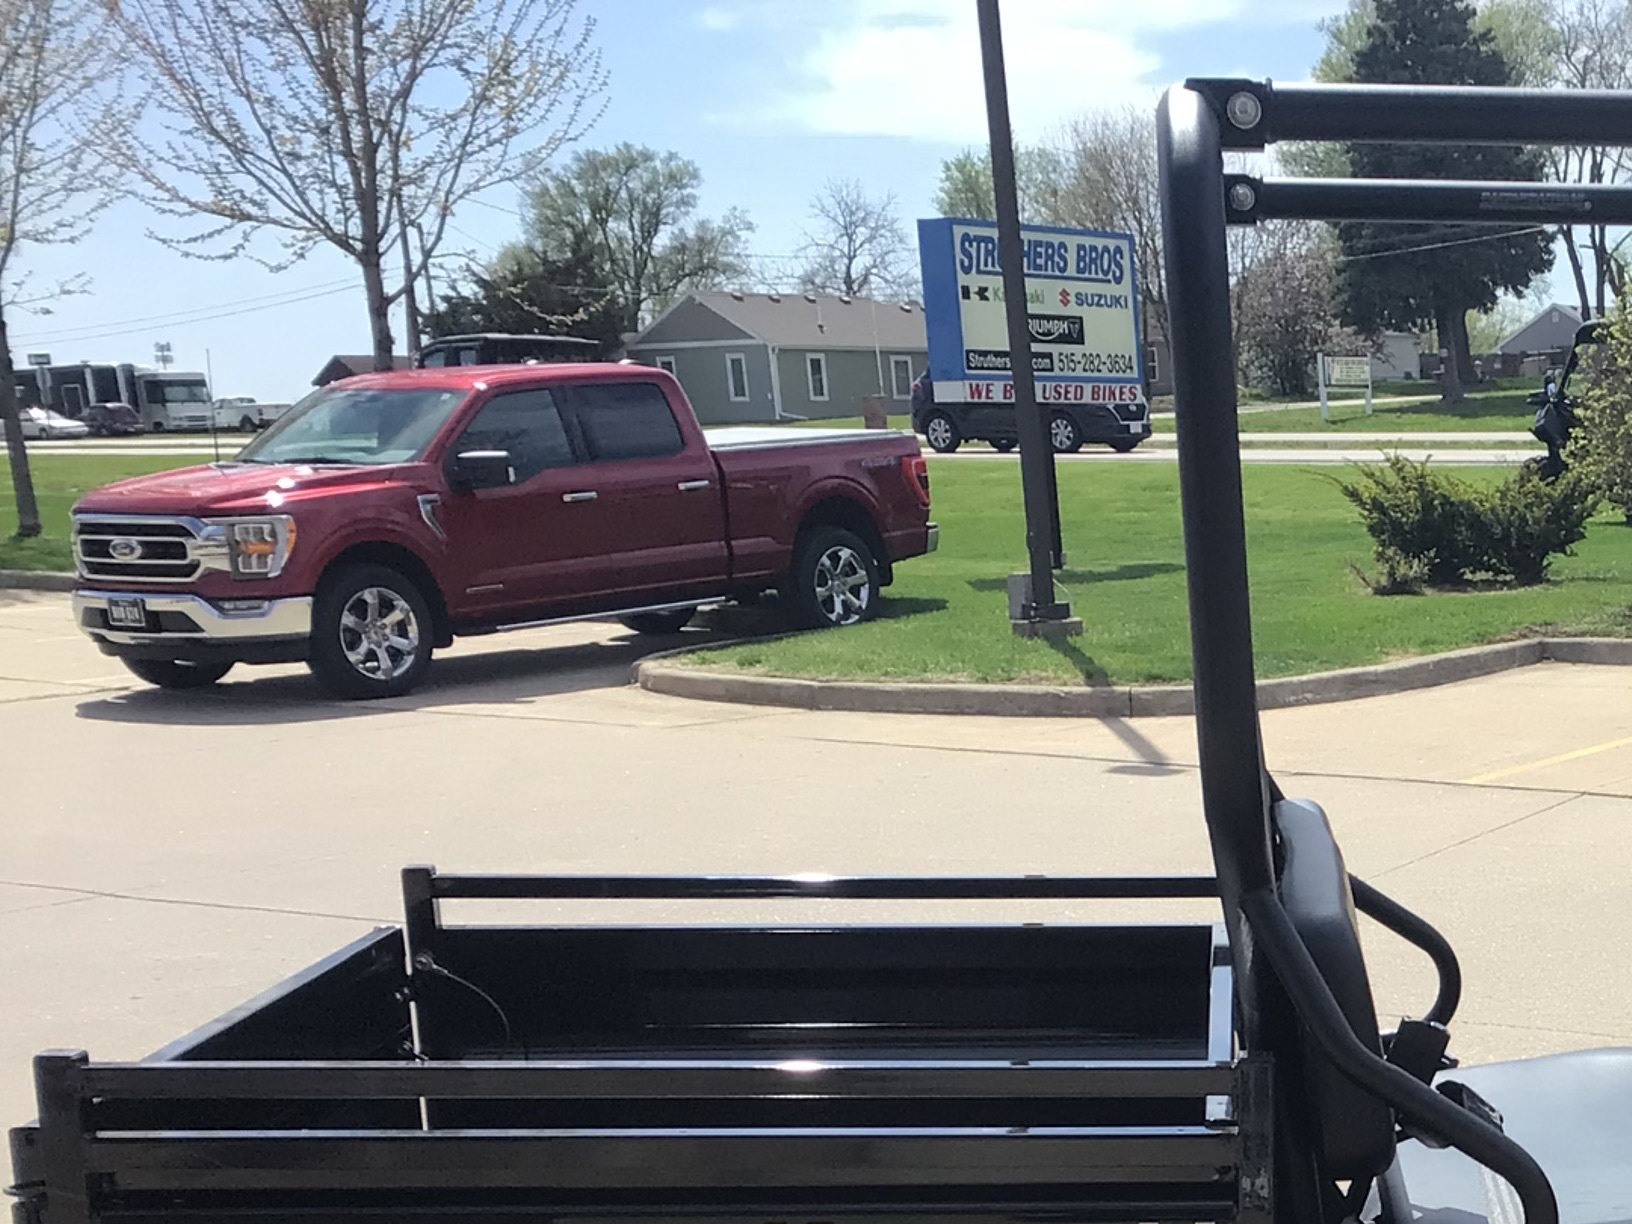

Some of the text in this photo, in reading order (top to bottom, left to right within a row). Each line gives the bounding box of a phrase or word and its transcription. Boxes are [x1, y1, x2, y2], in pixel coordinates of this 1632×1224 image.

[960, 232, 1124, 285] STRHERS BROS
[1074, 291, 1128, 309] SUZUKI
[1027, 318, 1069, 334] RIUMPH
[1058, 352, 1133, 373] 515-282-3634
[969, 383, 994, 400] WE
[1042, 384, 1084, 401] USED
[1091, 385, 1137, 402] BIKES
